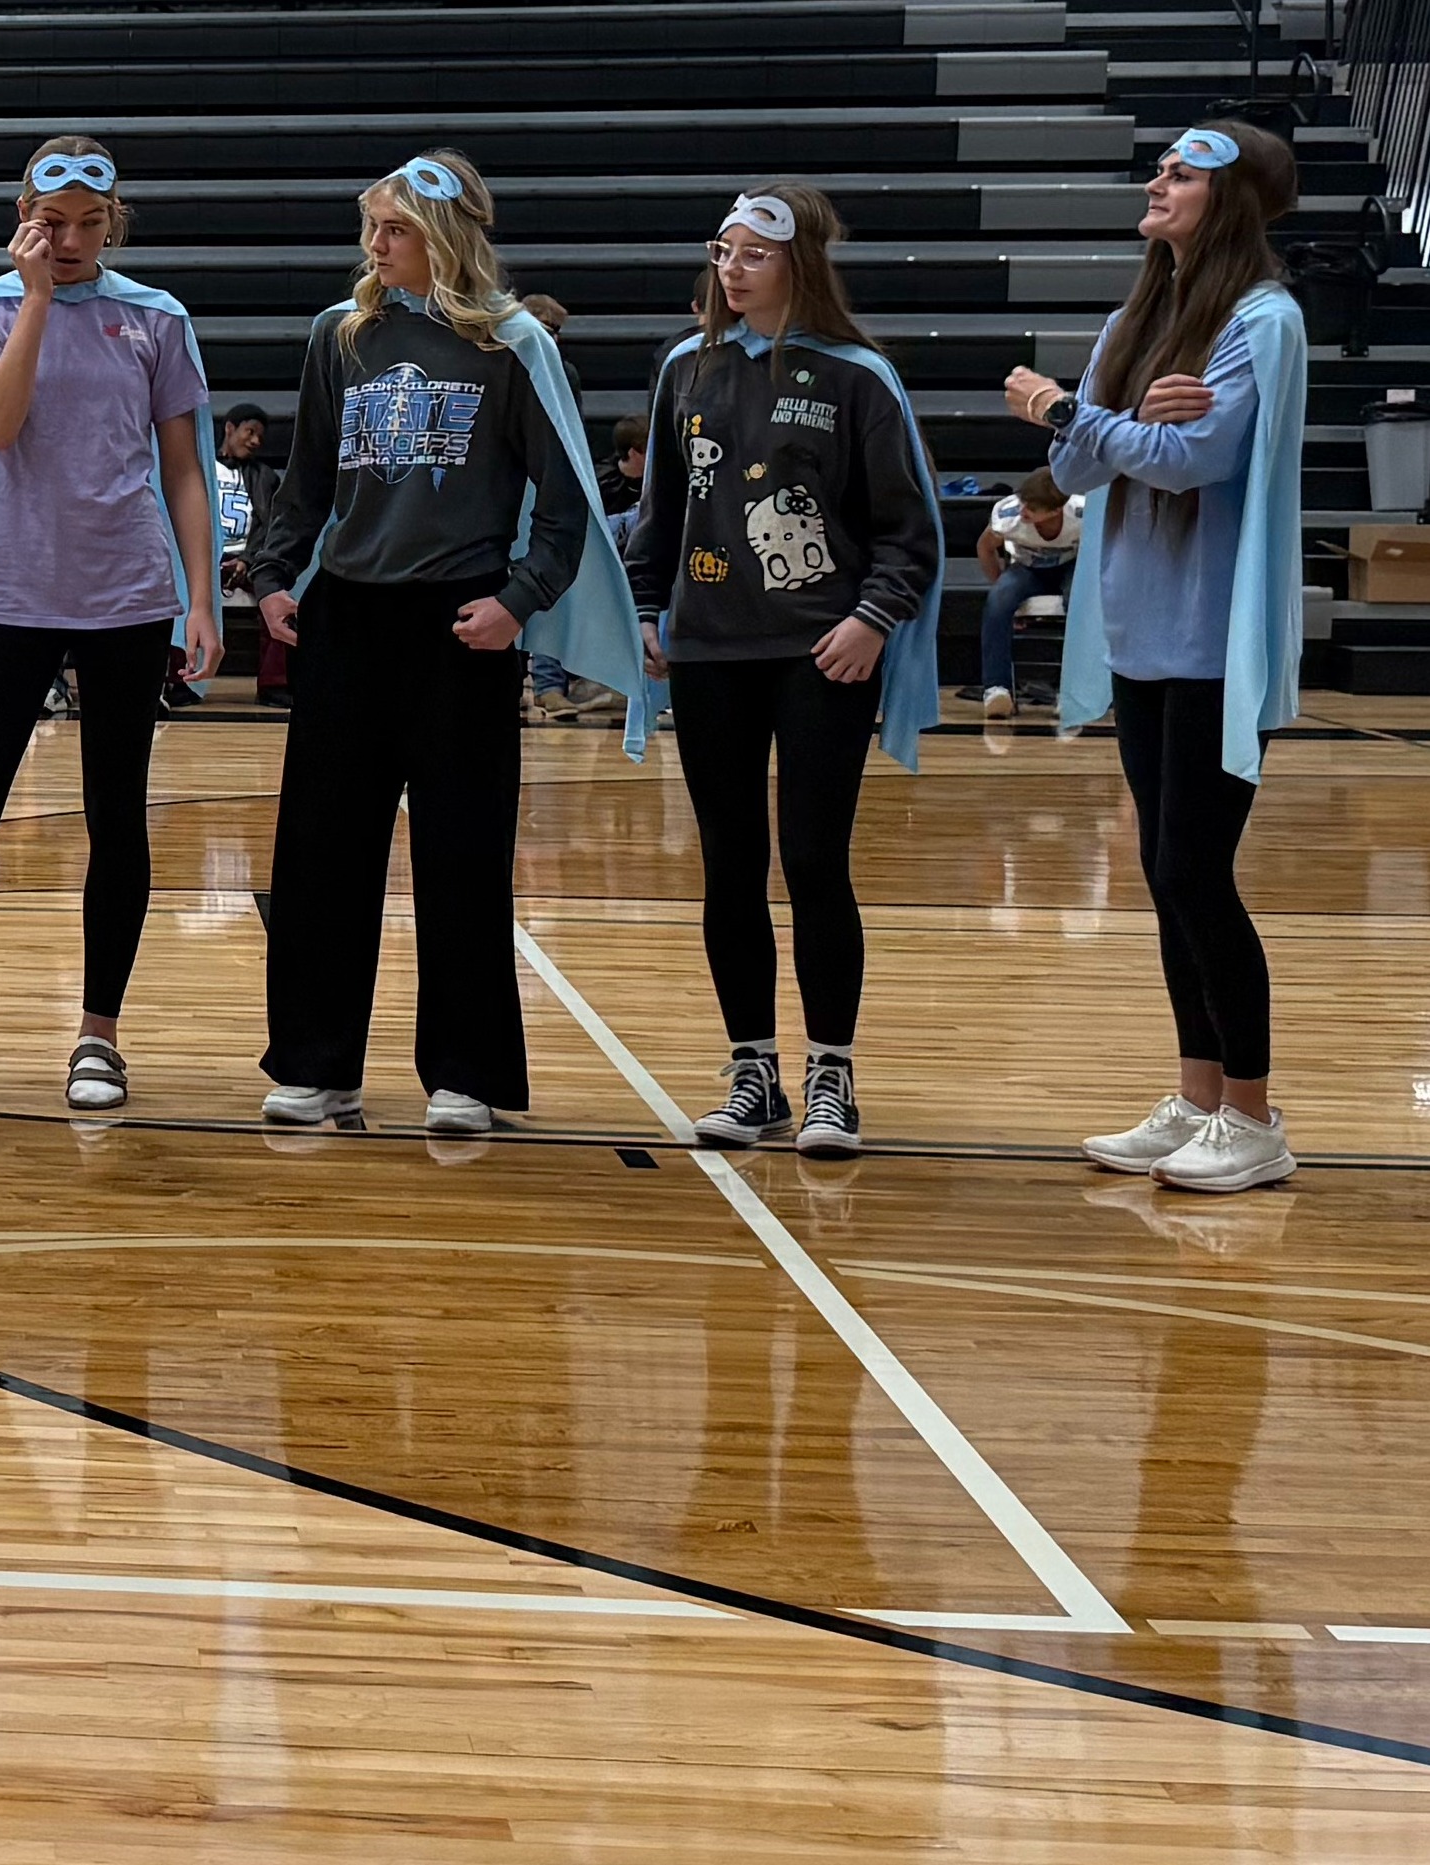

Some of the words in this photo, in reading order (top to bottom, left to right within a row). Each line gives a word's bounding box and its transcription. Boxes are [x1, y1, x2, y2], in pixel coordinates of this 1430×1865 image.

[342, 390, 482, 437] STATE
[776, 397, 809, 412] HELLO
[810, 401, 838, 419] KITTY
[770, 409, 793, 424] AND
[794, 412, 835, 433] FRIENDS
